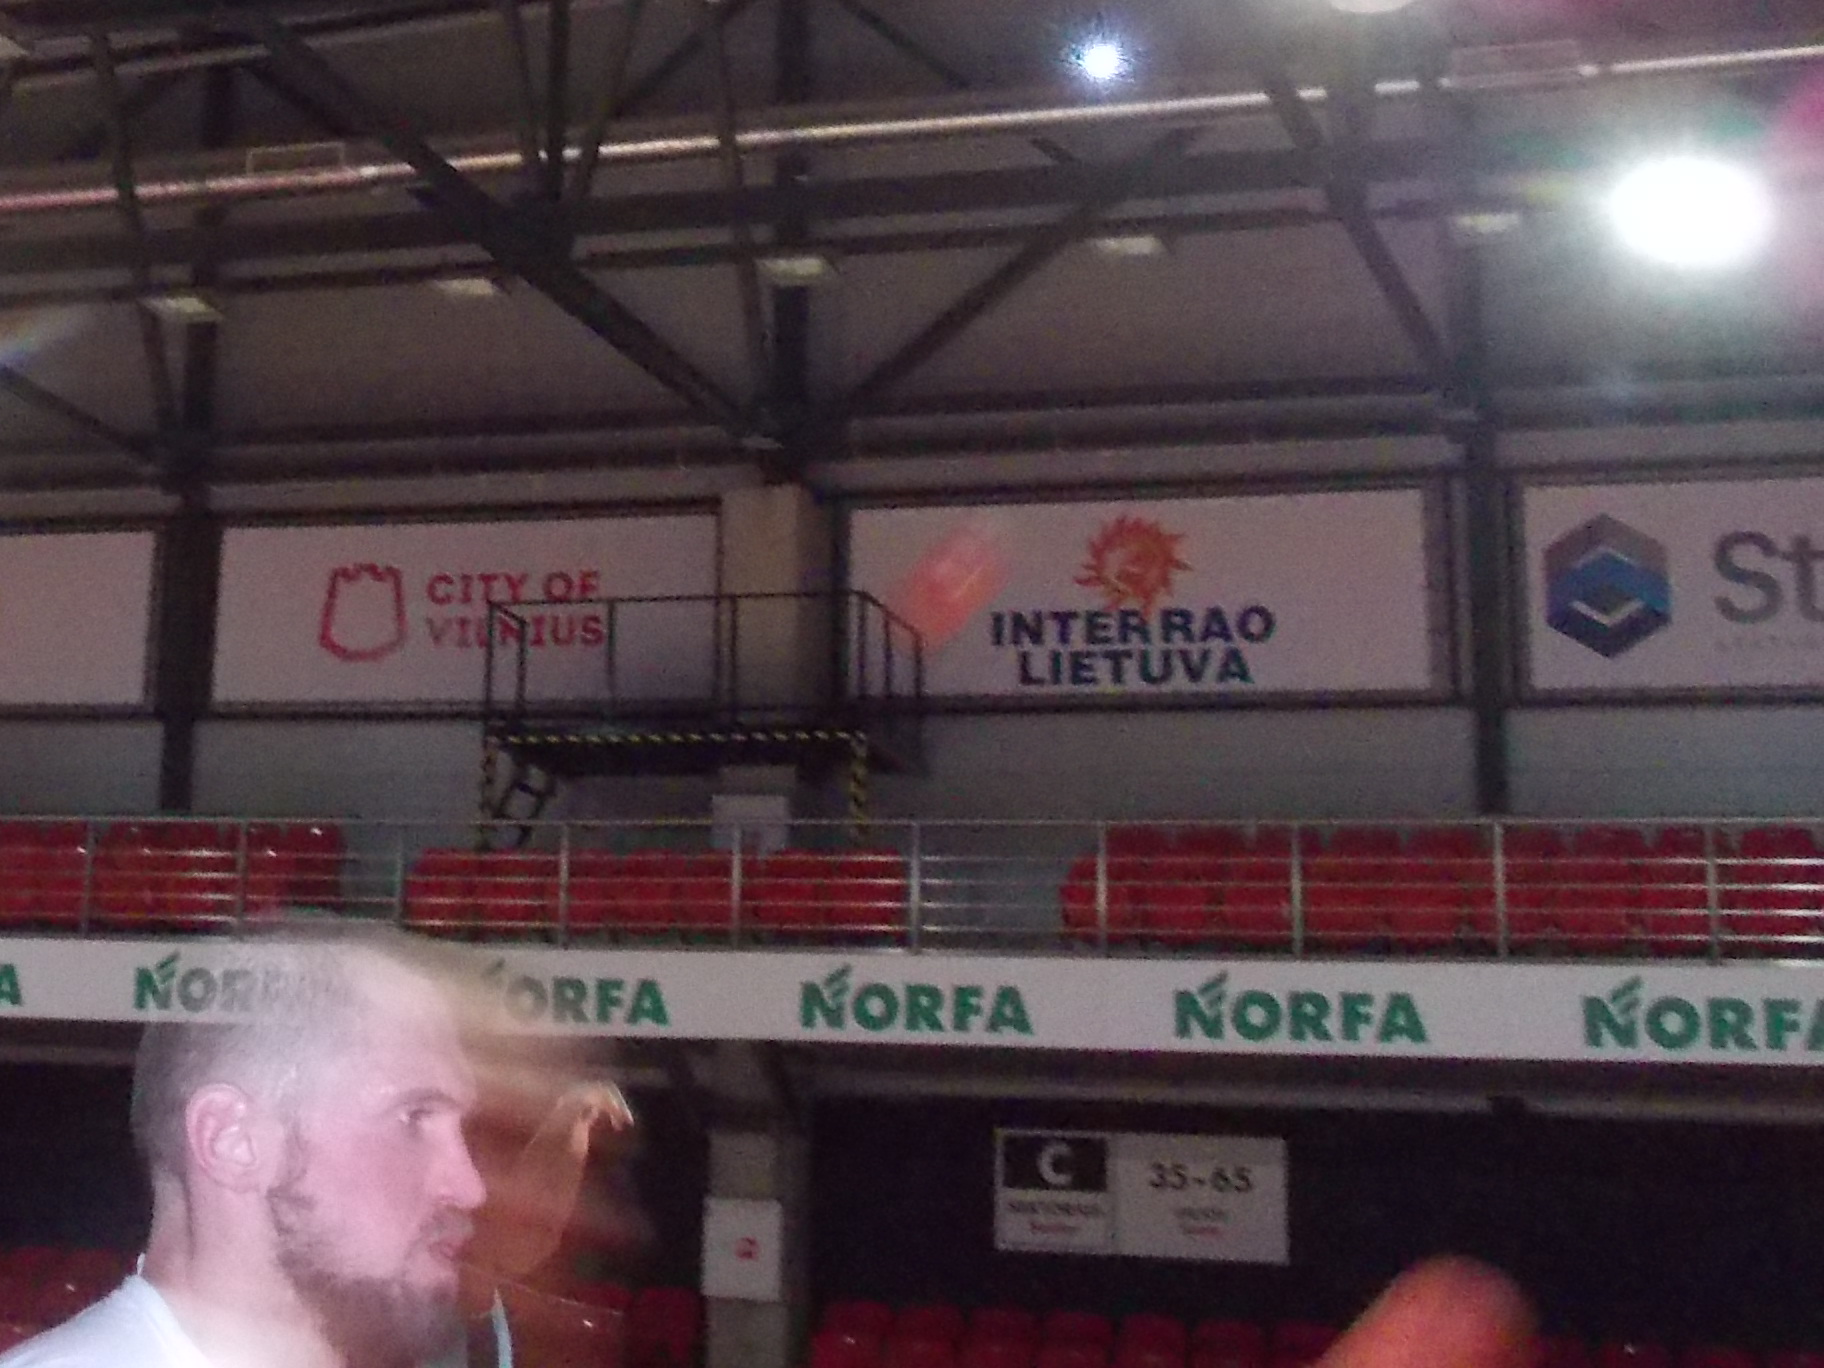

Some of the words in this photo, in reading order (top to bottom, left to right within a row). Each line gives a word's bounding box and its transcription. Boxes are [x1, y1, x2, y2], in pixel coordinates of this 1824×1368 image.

[426, 571, 527, 605] CITY
[543, 569, 597, 604] OF
[426, 615, 605, 649] VILNIUS
[990, 609, 1158, 646] INTER
[1165, 604, 1275, 645] RAO
[1018, 648, 1255, 685] LIETUVA
[799, 963, 1033, 1035] NORFA
[1173, 970, 1428, 1045] NORFA
[1038, 1142, 1073, 1185] C
[1150, 1161, 1253, 1194] 35-65
